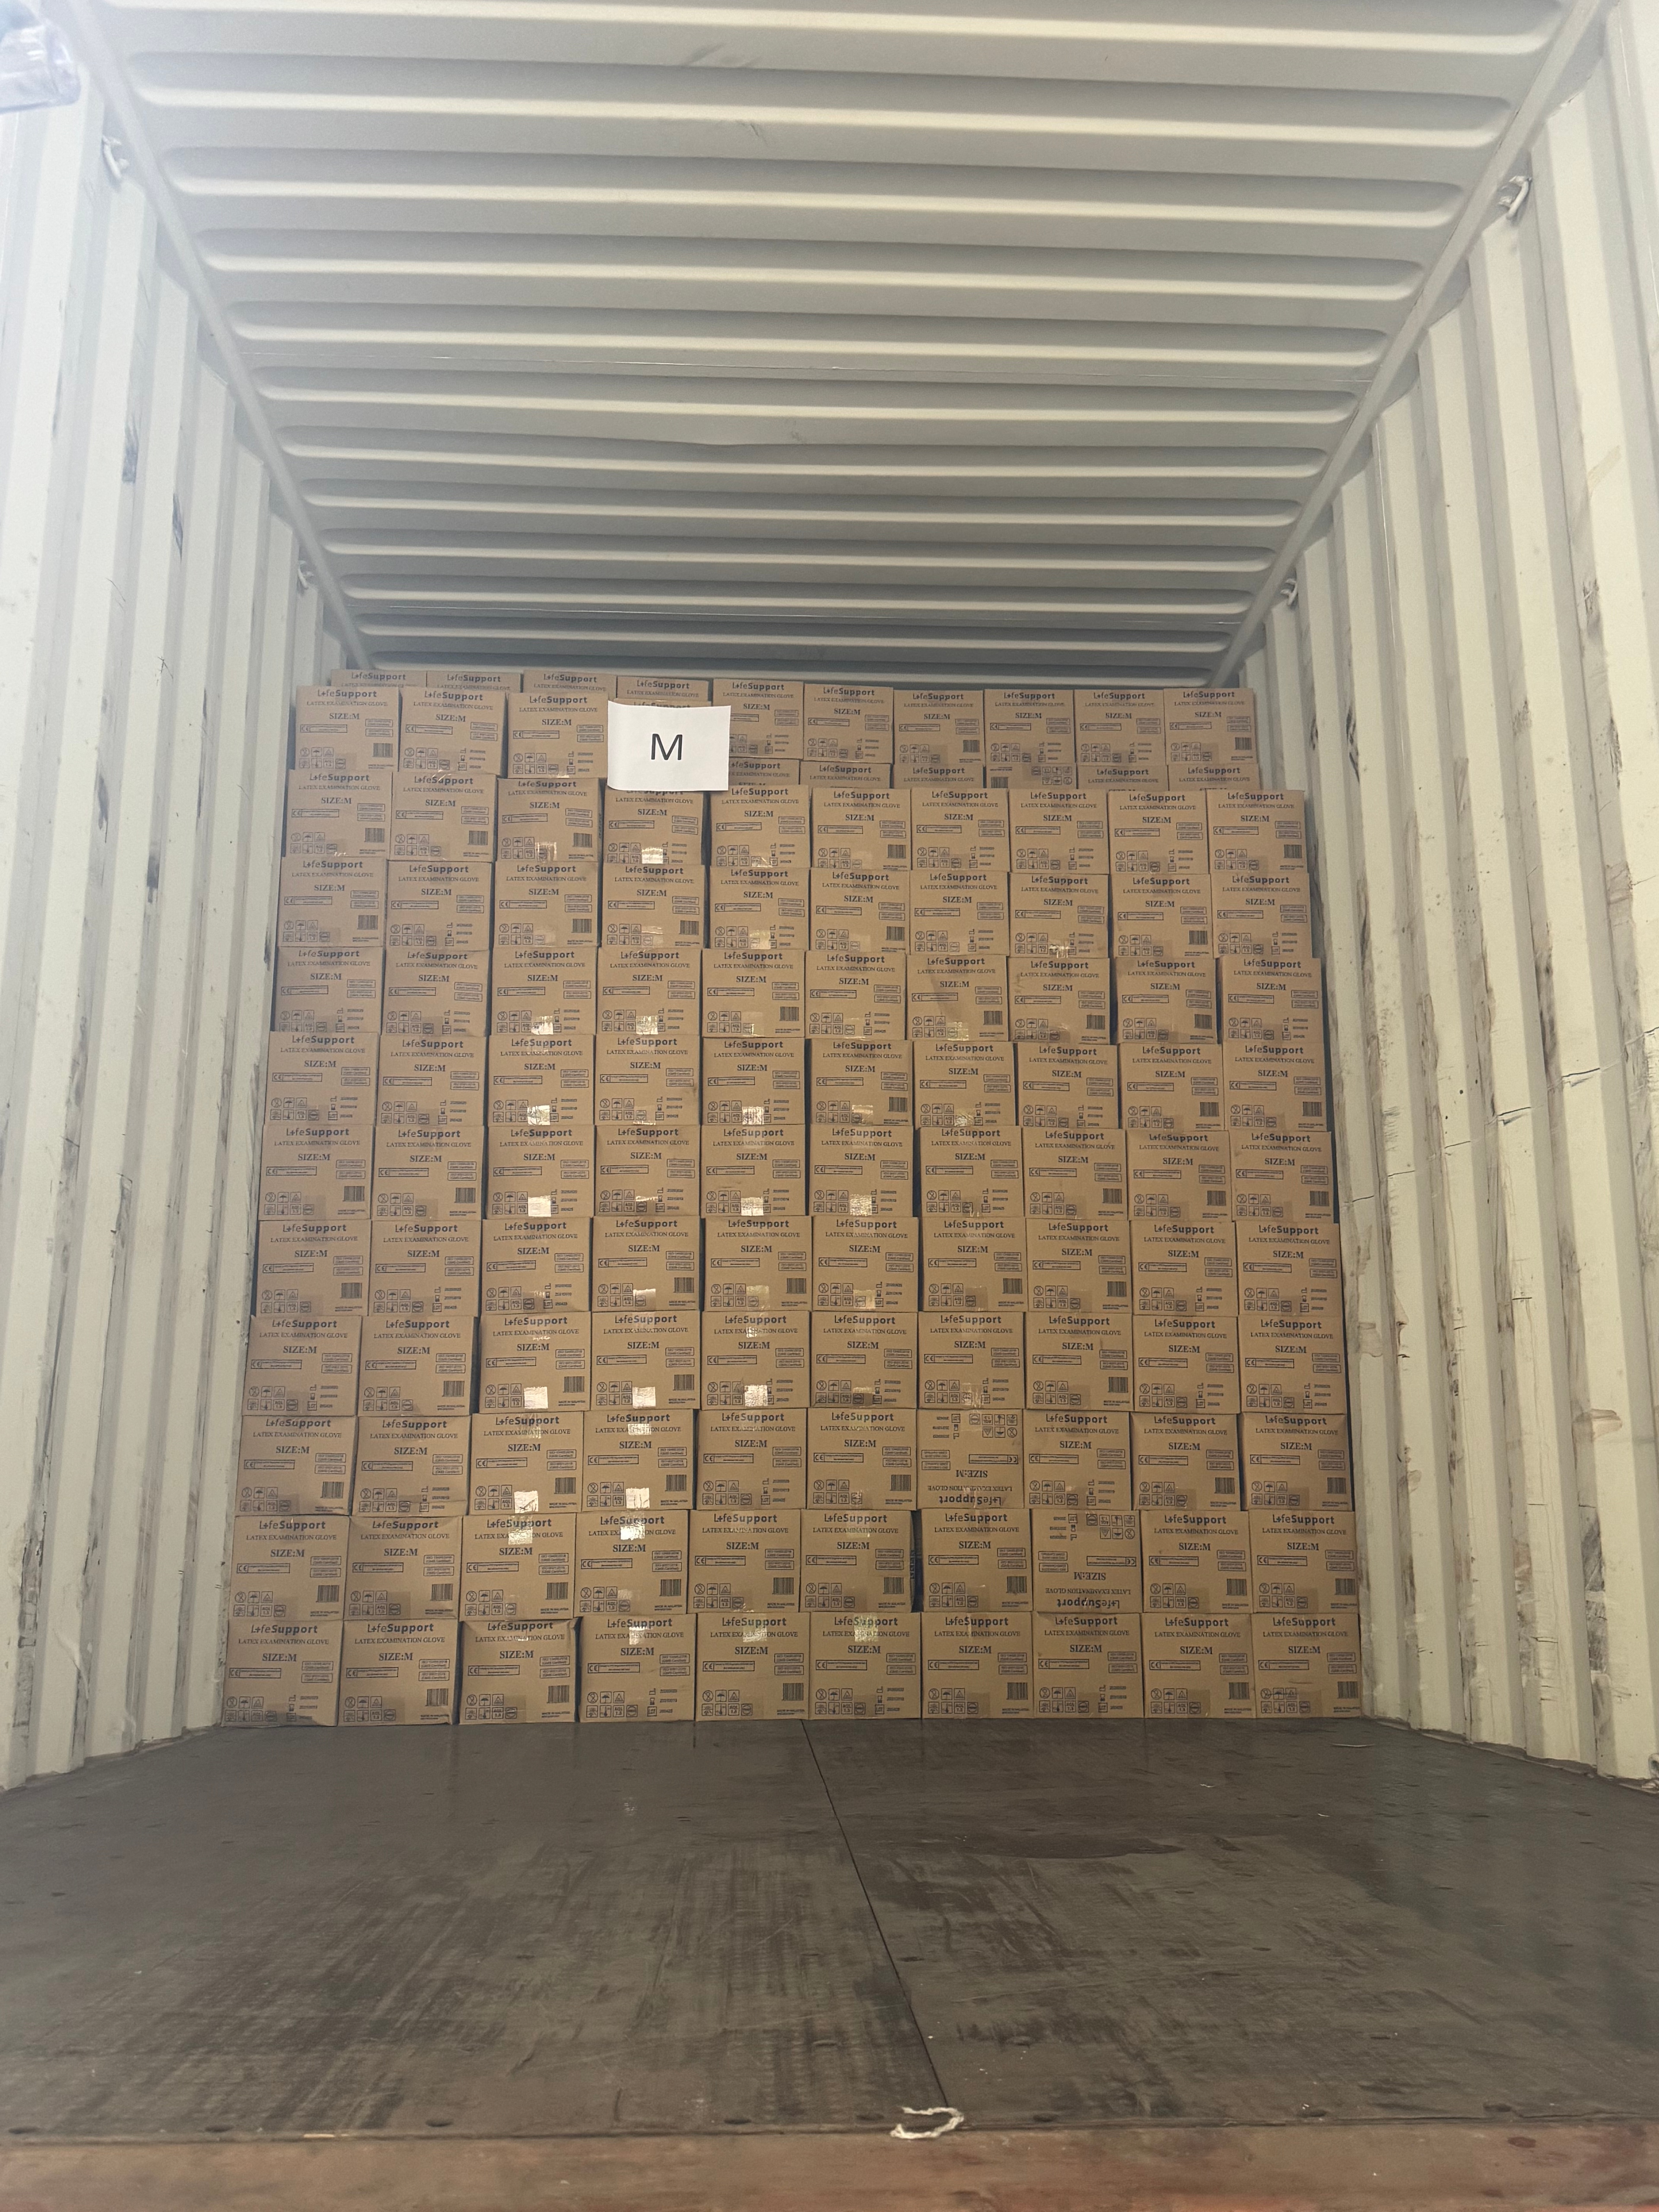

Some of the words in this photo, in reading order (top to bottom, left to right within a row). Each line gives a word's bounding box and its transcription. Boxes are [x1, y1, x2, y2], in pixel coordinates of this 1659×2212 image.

[651, 734, 682, 760] M
[283, 1346, 317, 1354] SIZE:M
[394, 1447, 427, 1455] SIZE:M
[263, 1653, 296, 1662] SIZE:M
